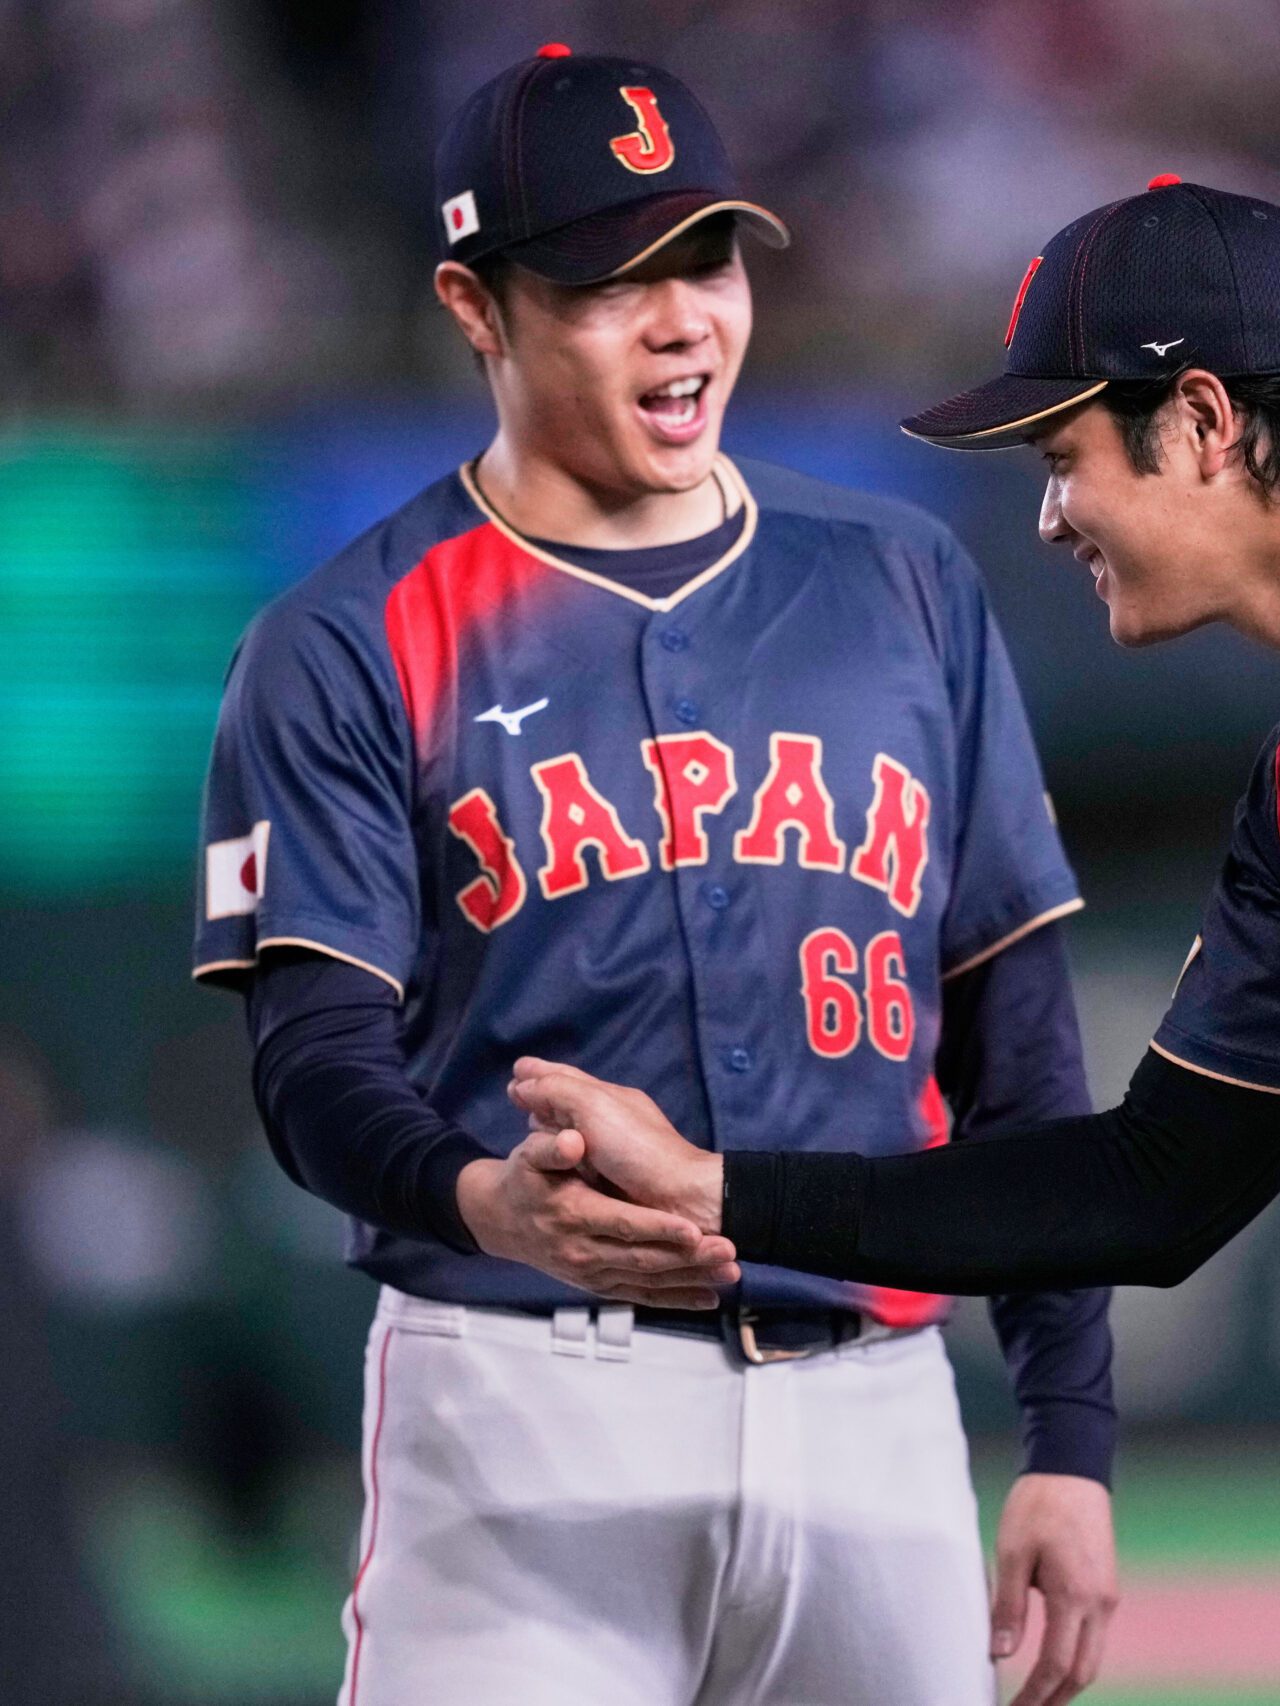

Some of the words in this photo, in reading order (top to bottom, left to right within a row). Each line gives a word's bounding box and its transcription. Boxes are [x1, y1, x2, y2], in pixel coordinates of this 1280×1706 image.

[609, 86, 676, 175] J
[449, 731, 931, 934] JAPAN
[800, 926, 916, 1061] 66
